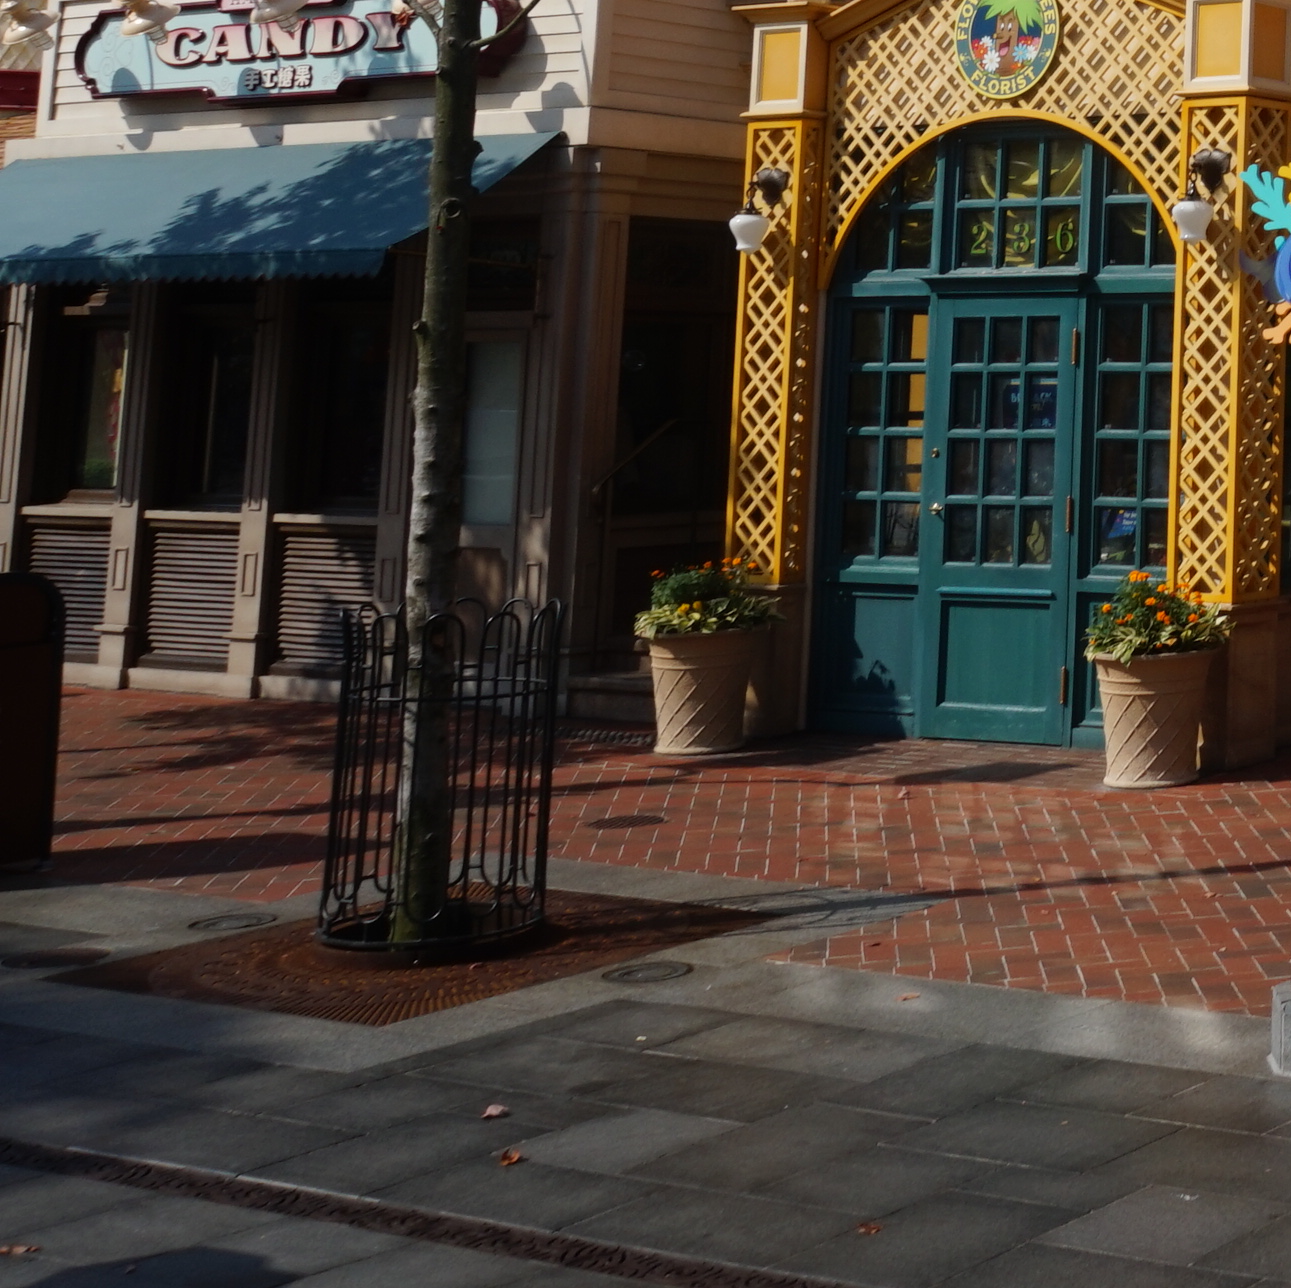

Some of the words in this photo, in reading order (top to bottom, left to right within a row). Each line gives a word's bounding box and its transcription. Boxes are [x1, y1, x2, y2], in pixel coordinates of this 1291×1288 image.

[155, 11, 410, 67] CANDY
[244, 65, 313, 90] 手工糖果
[971, 66, 1036, 94] FLORIST
